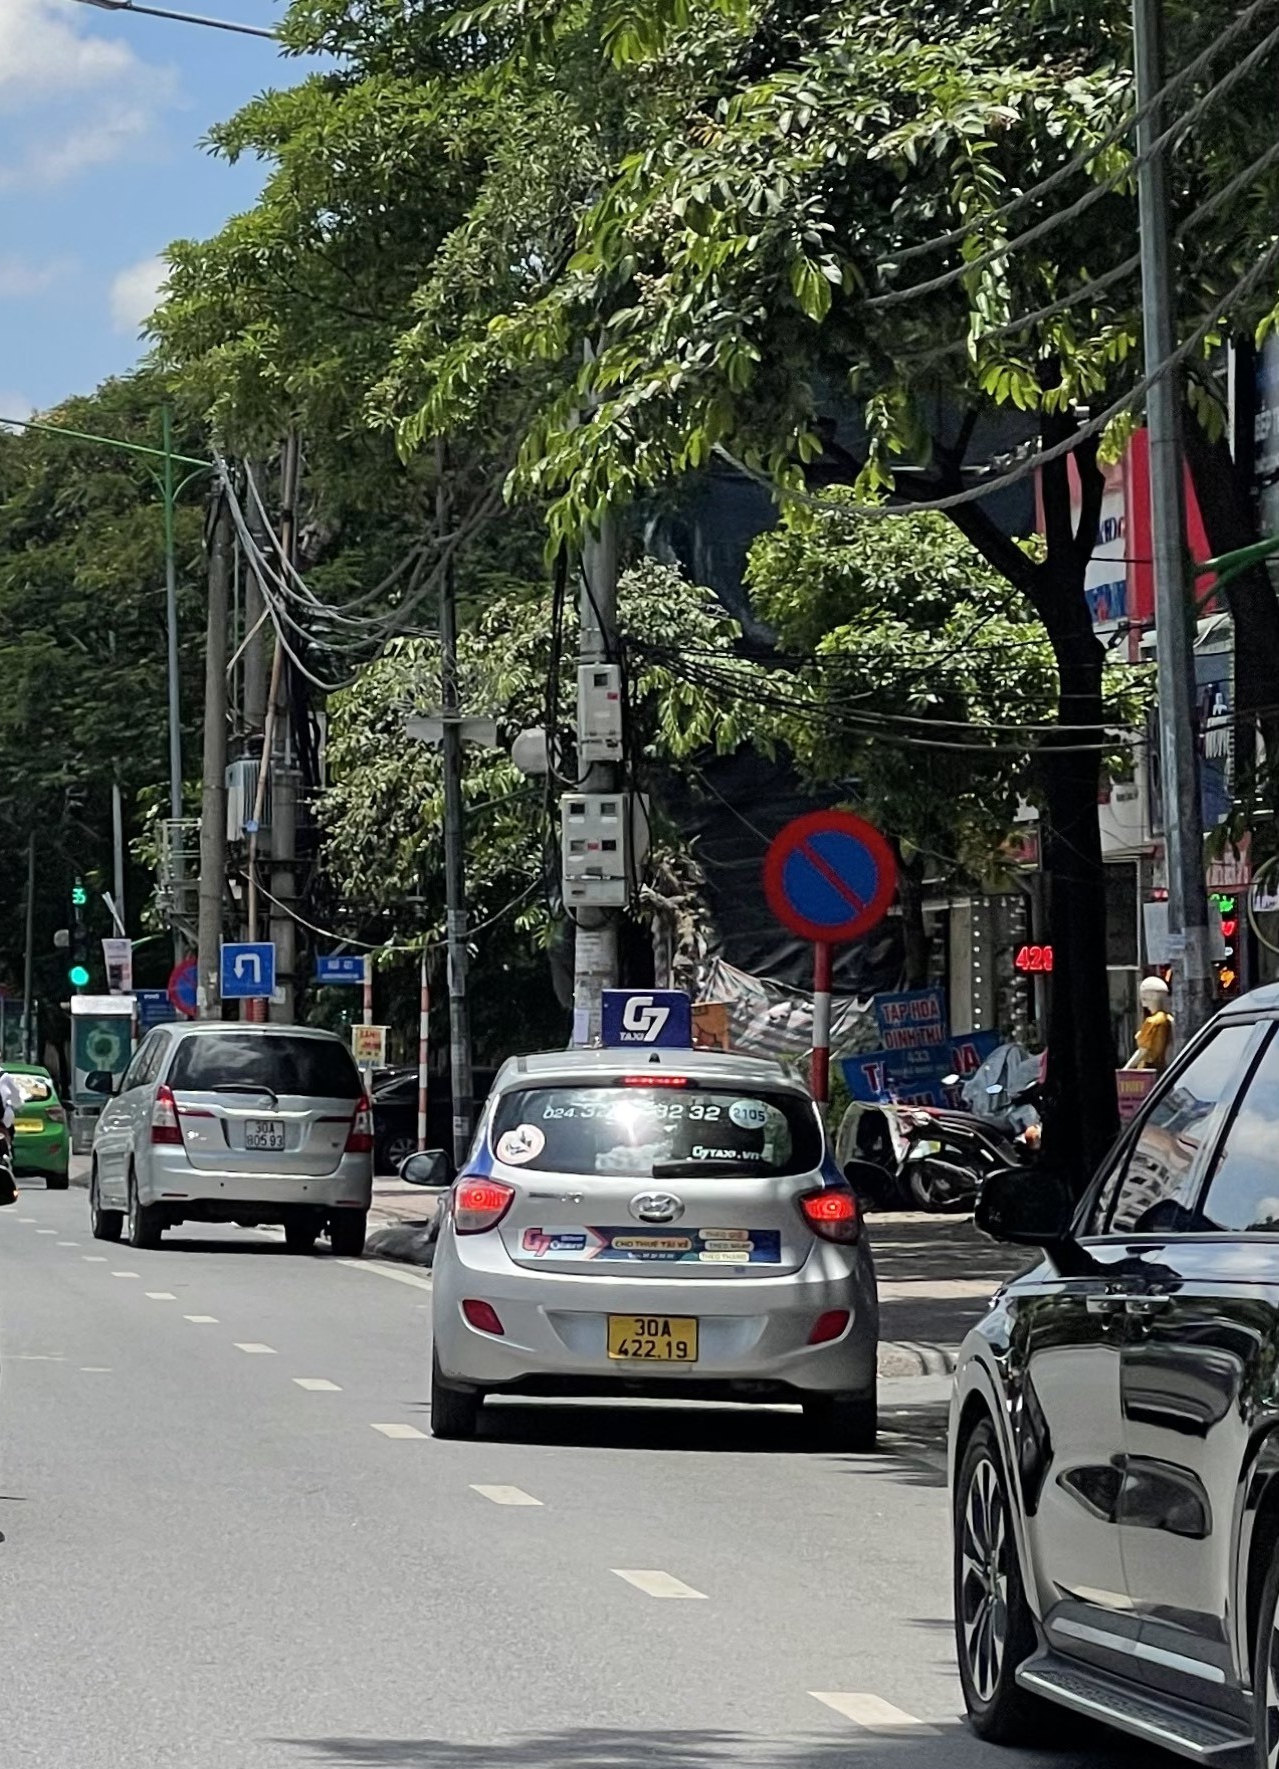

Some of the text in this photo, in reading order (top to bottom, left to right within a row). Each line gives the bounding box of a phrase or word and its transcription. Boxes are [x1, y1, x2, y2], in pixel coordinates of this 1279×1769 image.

[622, 996, 670, 1042] G7
[619, 1031, 645, 1041] TAXI
[688, 1104, 721, 1122] 32
[733, 1105, 766, 1123] 2105
[255, 1120, 275, 1135] 30A
[633, 1318, 673, 1338] 30A
[617, 1338, 688, 1359] 422.19
